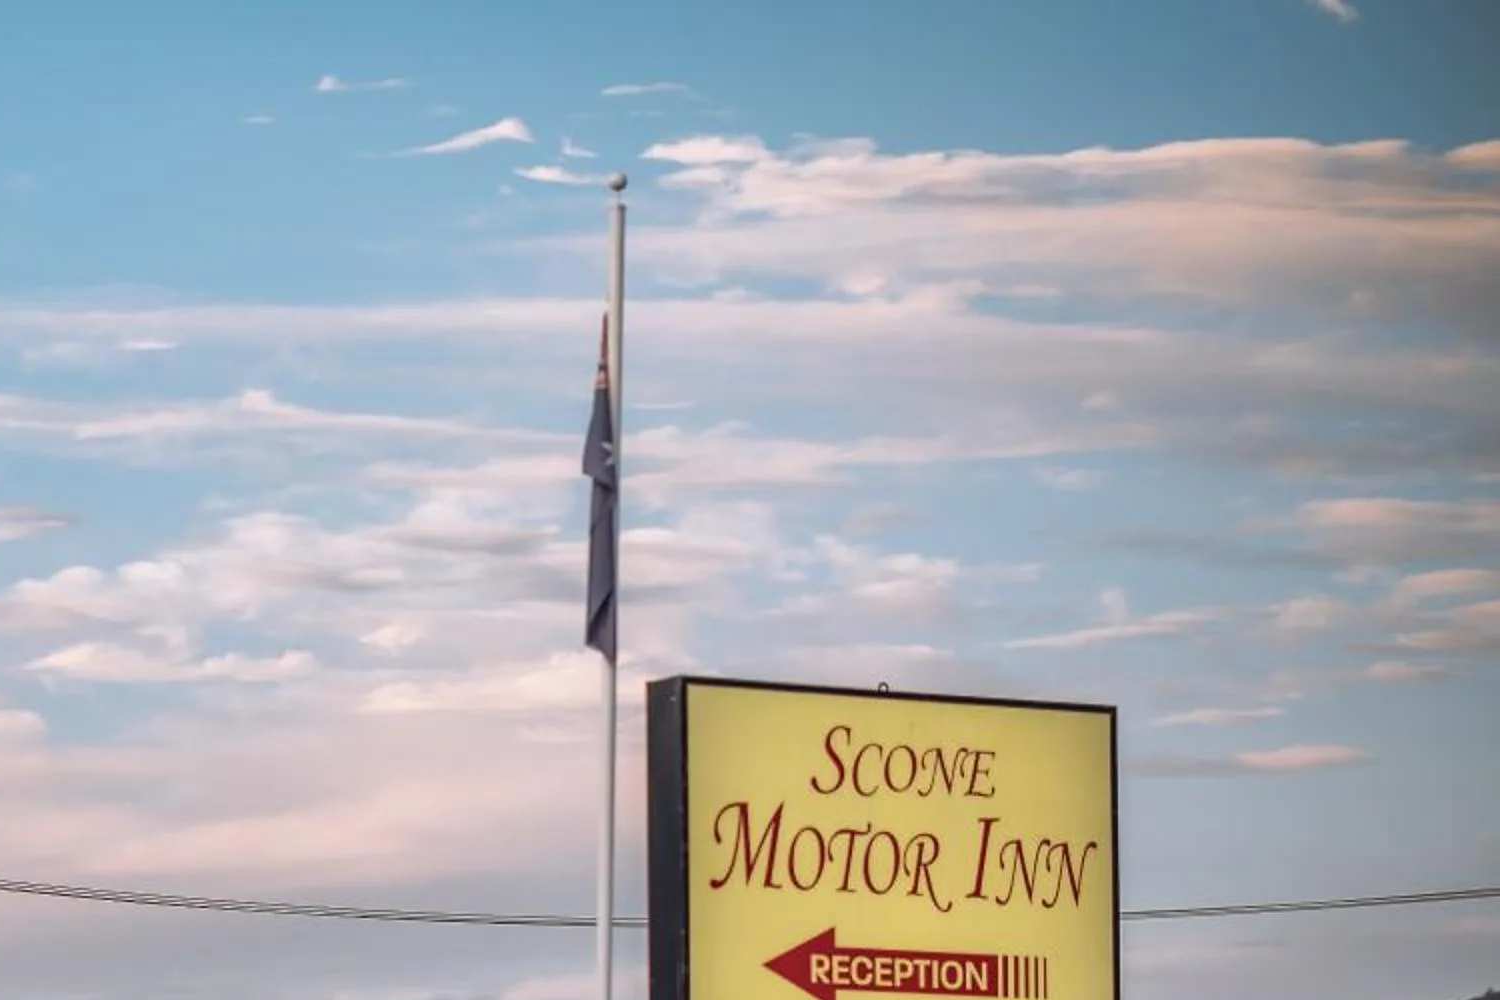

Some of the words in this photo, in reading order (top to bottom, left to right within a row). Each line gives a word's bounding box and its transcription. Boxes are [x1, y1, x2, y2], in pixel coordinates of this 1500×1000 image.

[810, 725, 997, 799] SCONE
[709, 800, 953, 914] MOTOR
[965, 817, 1098, 909] INN
[809, 953, 989, 991] RECEPTION
